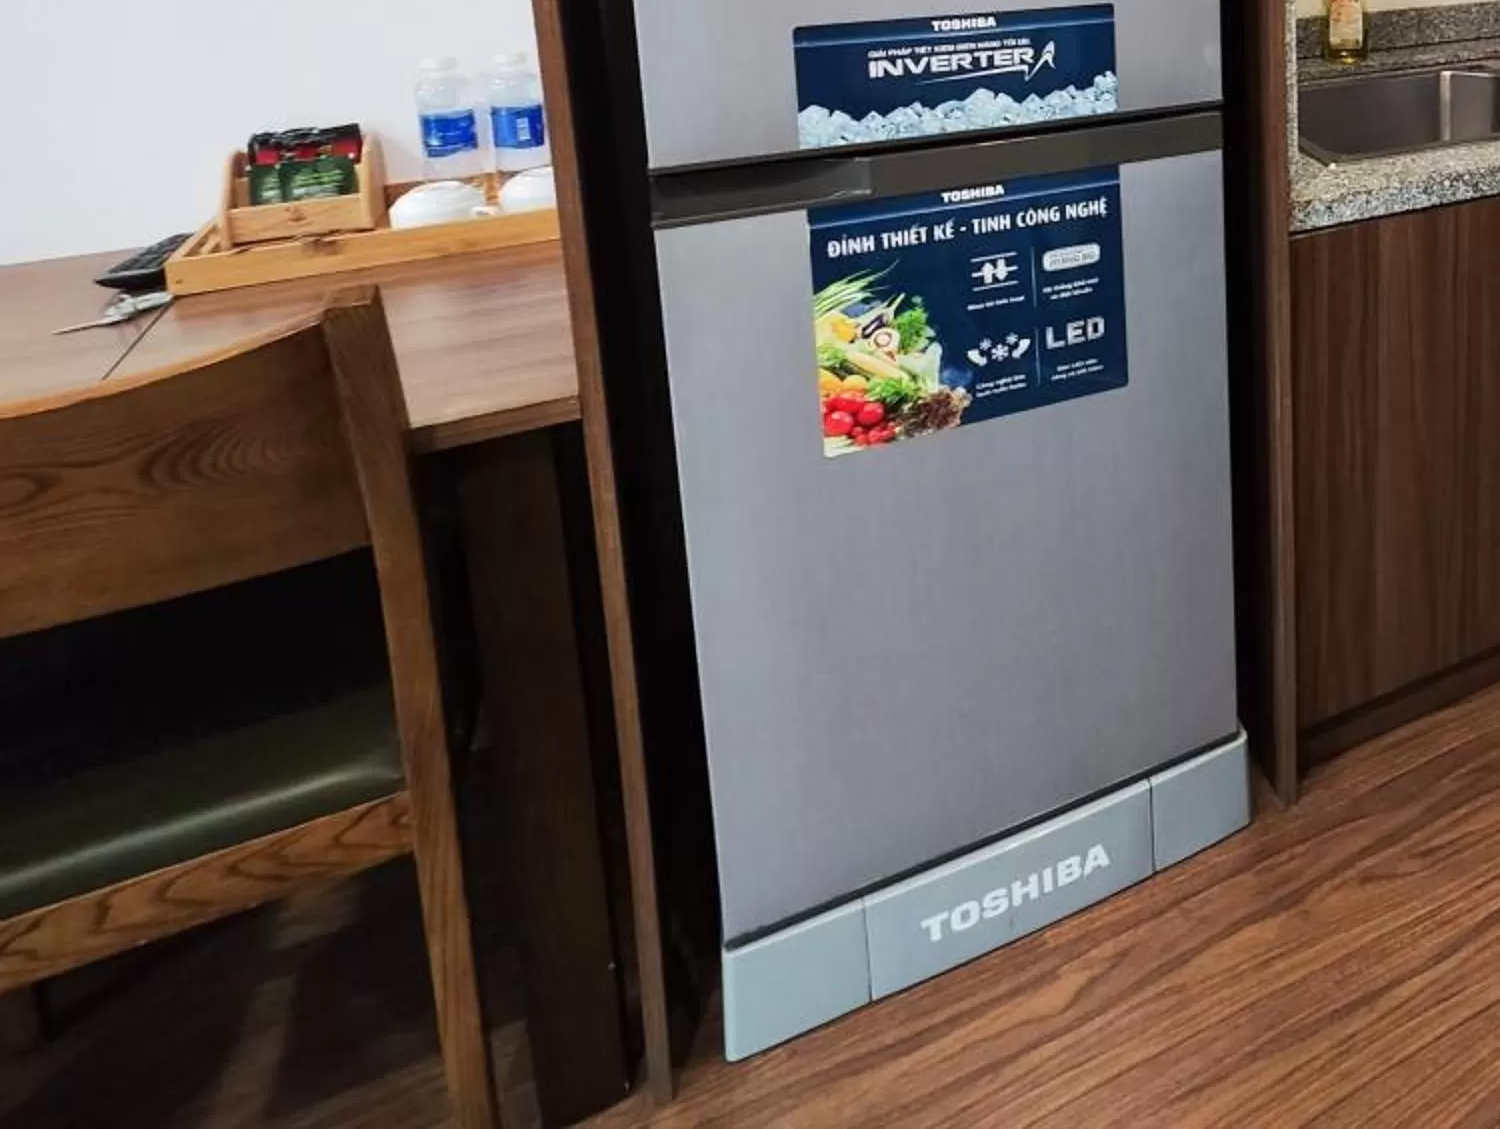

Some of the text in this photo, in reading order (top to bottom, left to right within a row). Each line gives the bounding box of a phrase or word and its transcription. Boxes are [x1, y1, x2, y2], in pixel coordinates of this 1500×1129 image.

[931, 16, 997, 32] TOSHIBA
[867, 47, 1035, 79] INVERTER
[941, 184, 1005, 203] TOSHIBA
[880, 222, 928, 249] THIẾT
[933, 216, 955, 241] KẾ
[1016, 206, 1061, 228] CÔNG
[1065, 196, 1108, 220] NGHỆ
[1045, 315, 1105, 350] LED
[920, 843, 1111, 942] TOSHIBA
